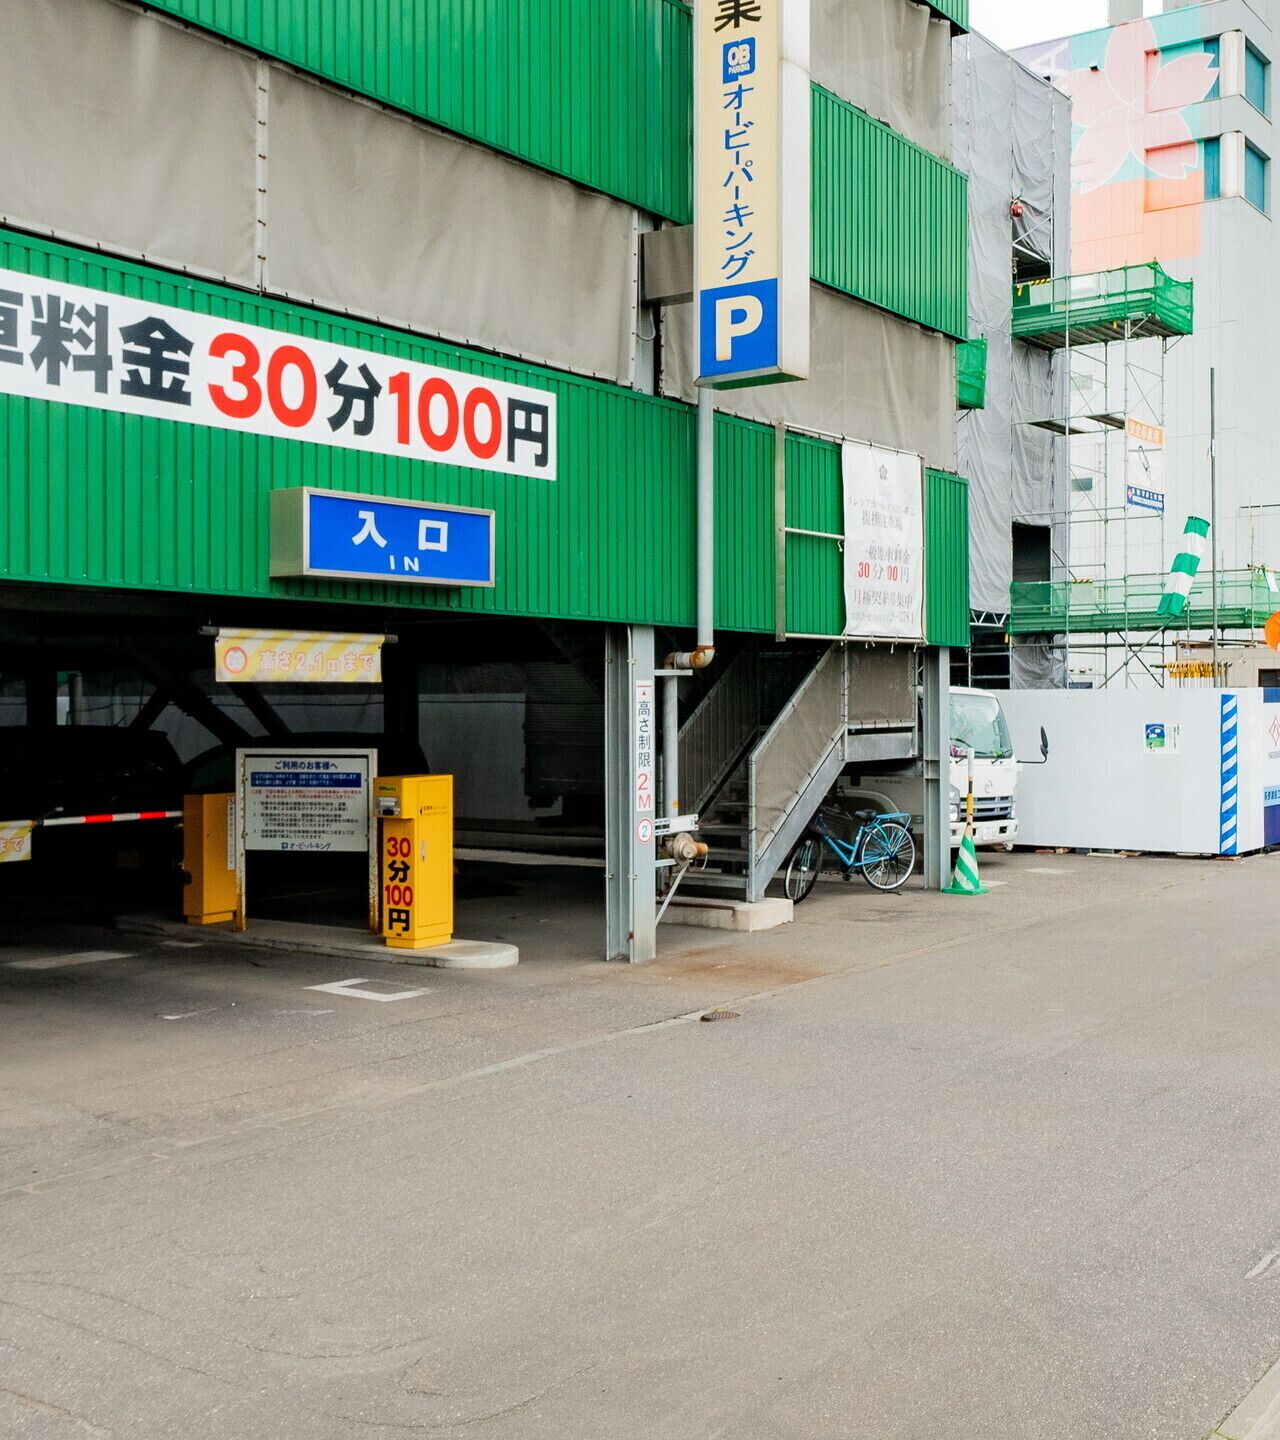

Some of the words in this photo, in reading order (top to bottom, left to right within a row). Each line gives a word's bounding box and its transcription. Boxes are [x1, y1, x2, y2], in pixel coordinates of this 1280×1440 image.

[722, 83, 754, 280] オービーパーキング
[715, 295, 763, 362] P
[352, 510, 449, 553] 入口
[389, 555, 420, 572] IN
